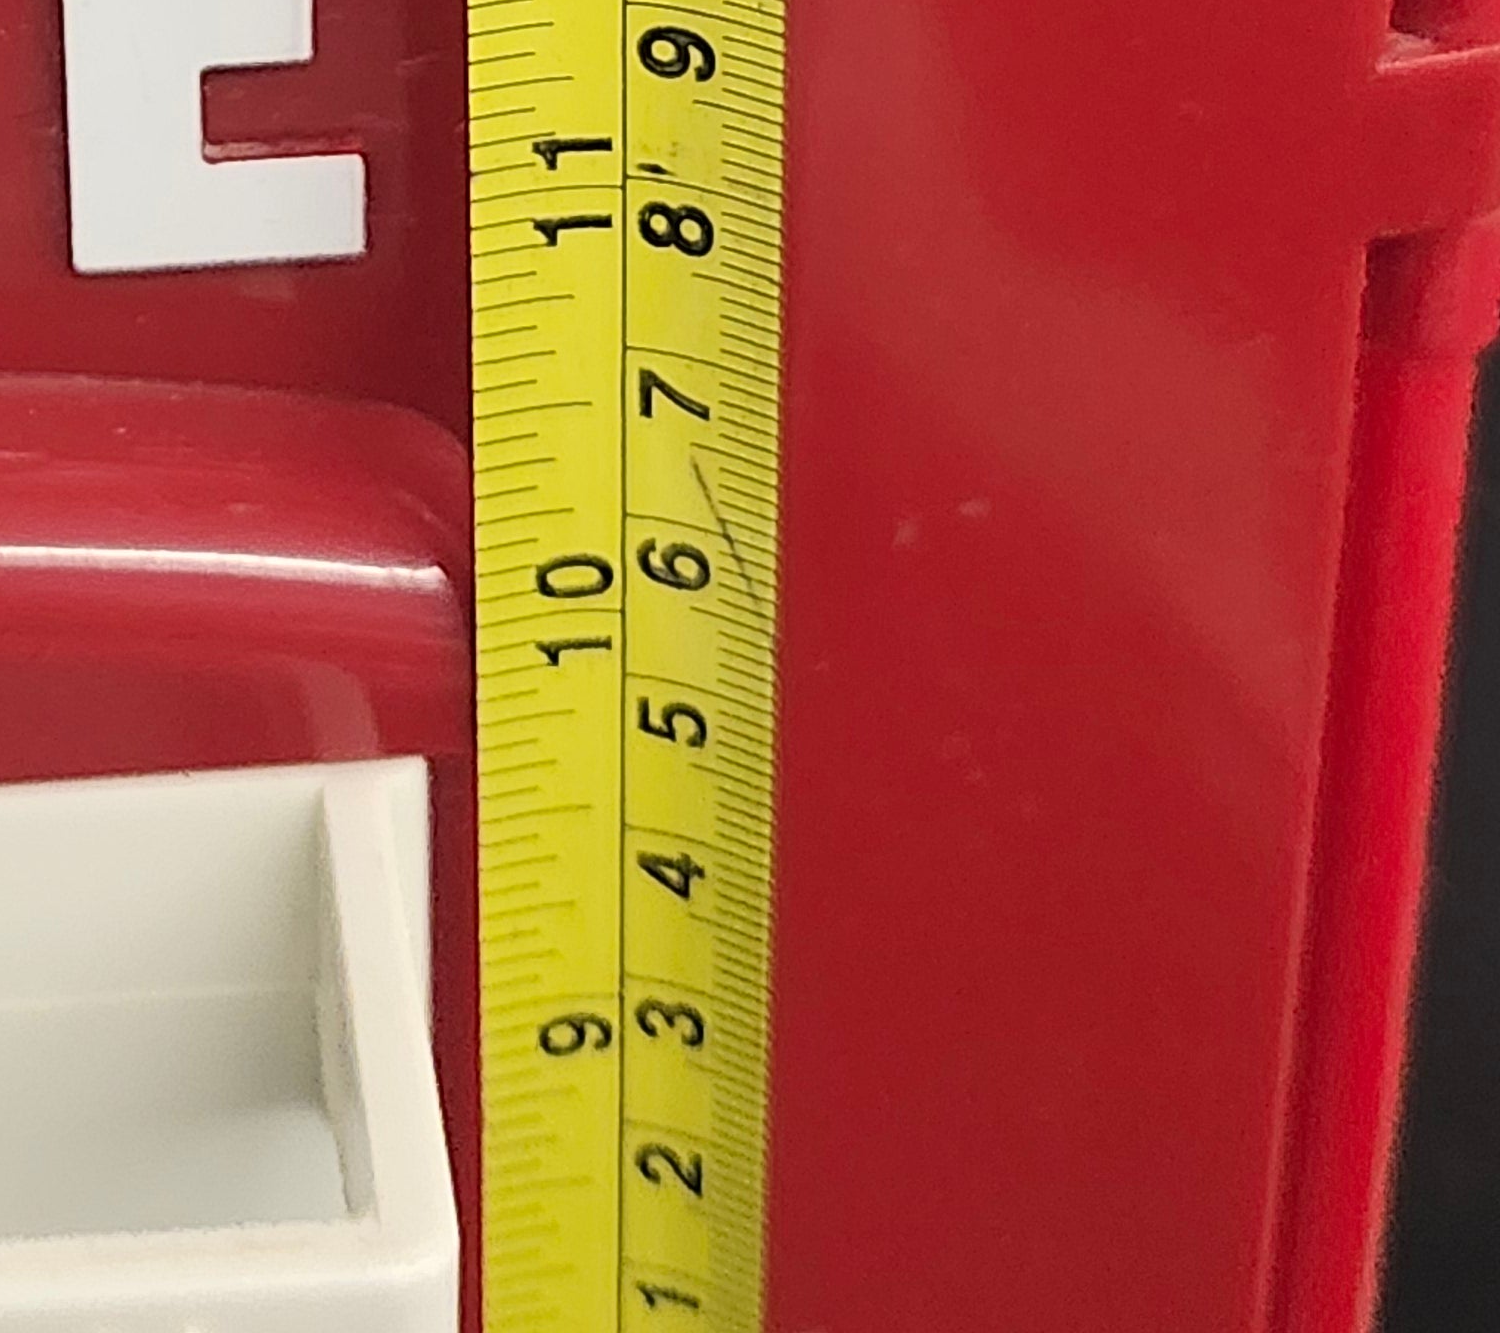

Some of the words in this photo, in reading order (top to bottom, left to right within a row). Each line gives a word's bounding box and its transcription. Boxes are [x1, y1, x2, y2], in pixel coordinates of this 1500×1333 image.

[637, 26, 716, 82] 9
[532, 137, 612, 246] 11
[638, 201, 714, 257] 8
[639, 368, 710, 422] 7
[637, 537, 710, 591] 6
[535, 553, 613, 666] 10
[637, 696, 707, 748] 5
[637, 850, 705, 900] 4
[539, 1012, 612, 1057] 9
[635, 998, 704, 1048] 3
[635, 1142, 703, 1198] 2
[636, 1281, 699, 1309] 1
